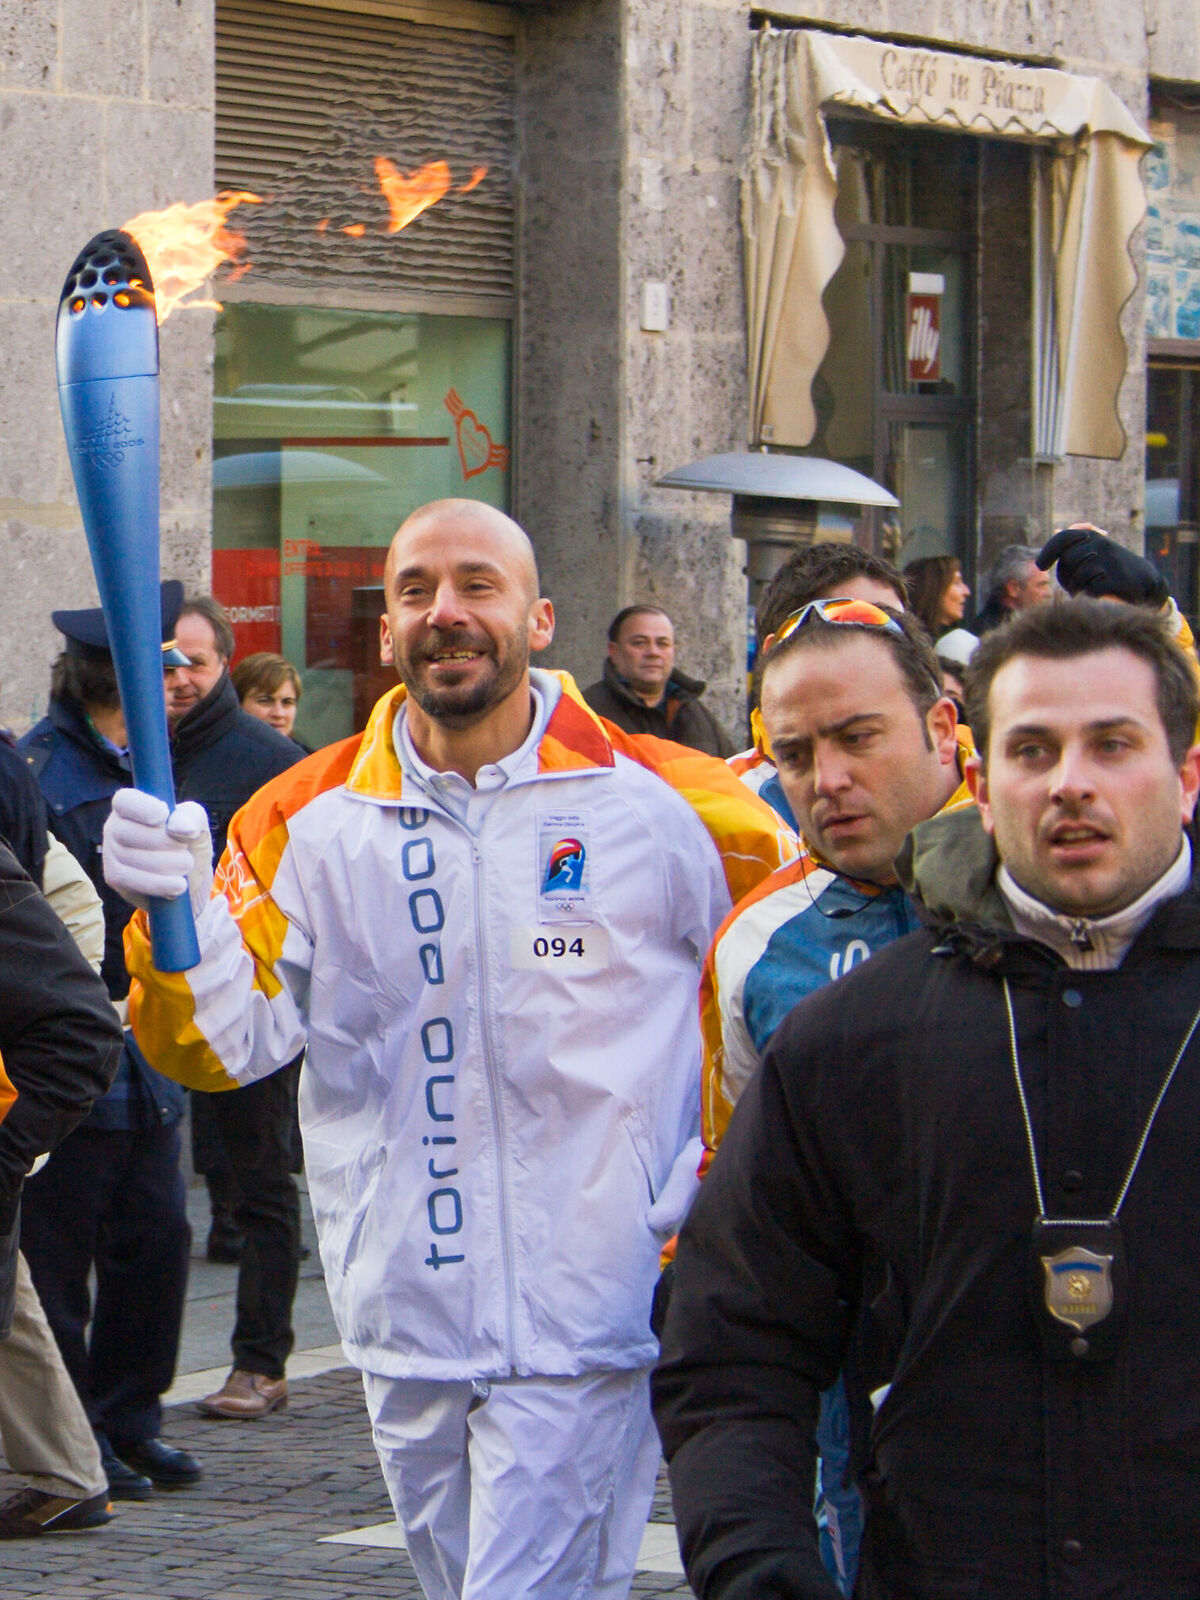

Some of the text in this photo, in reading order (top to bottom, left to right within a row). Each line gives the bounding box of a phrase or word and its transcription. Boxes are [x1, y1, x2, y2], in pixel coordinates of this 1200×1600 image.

[951, 61, 969, 101] in
[981, 66, 1045, 115] Piazza
[533, 937, 586, 958] 094
[420, 1017, 465, 1271] torino
